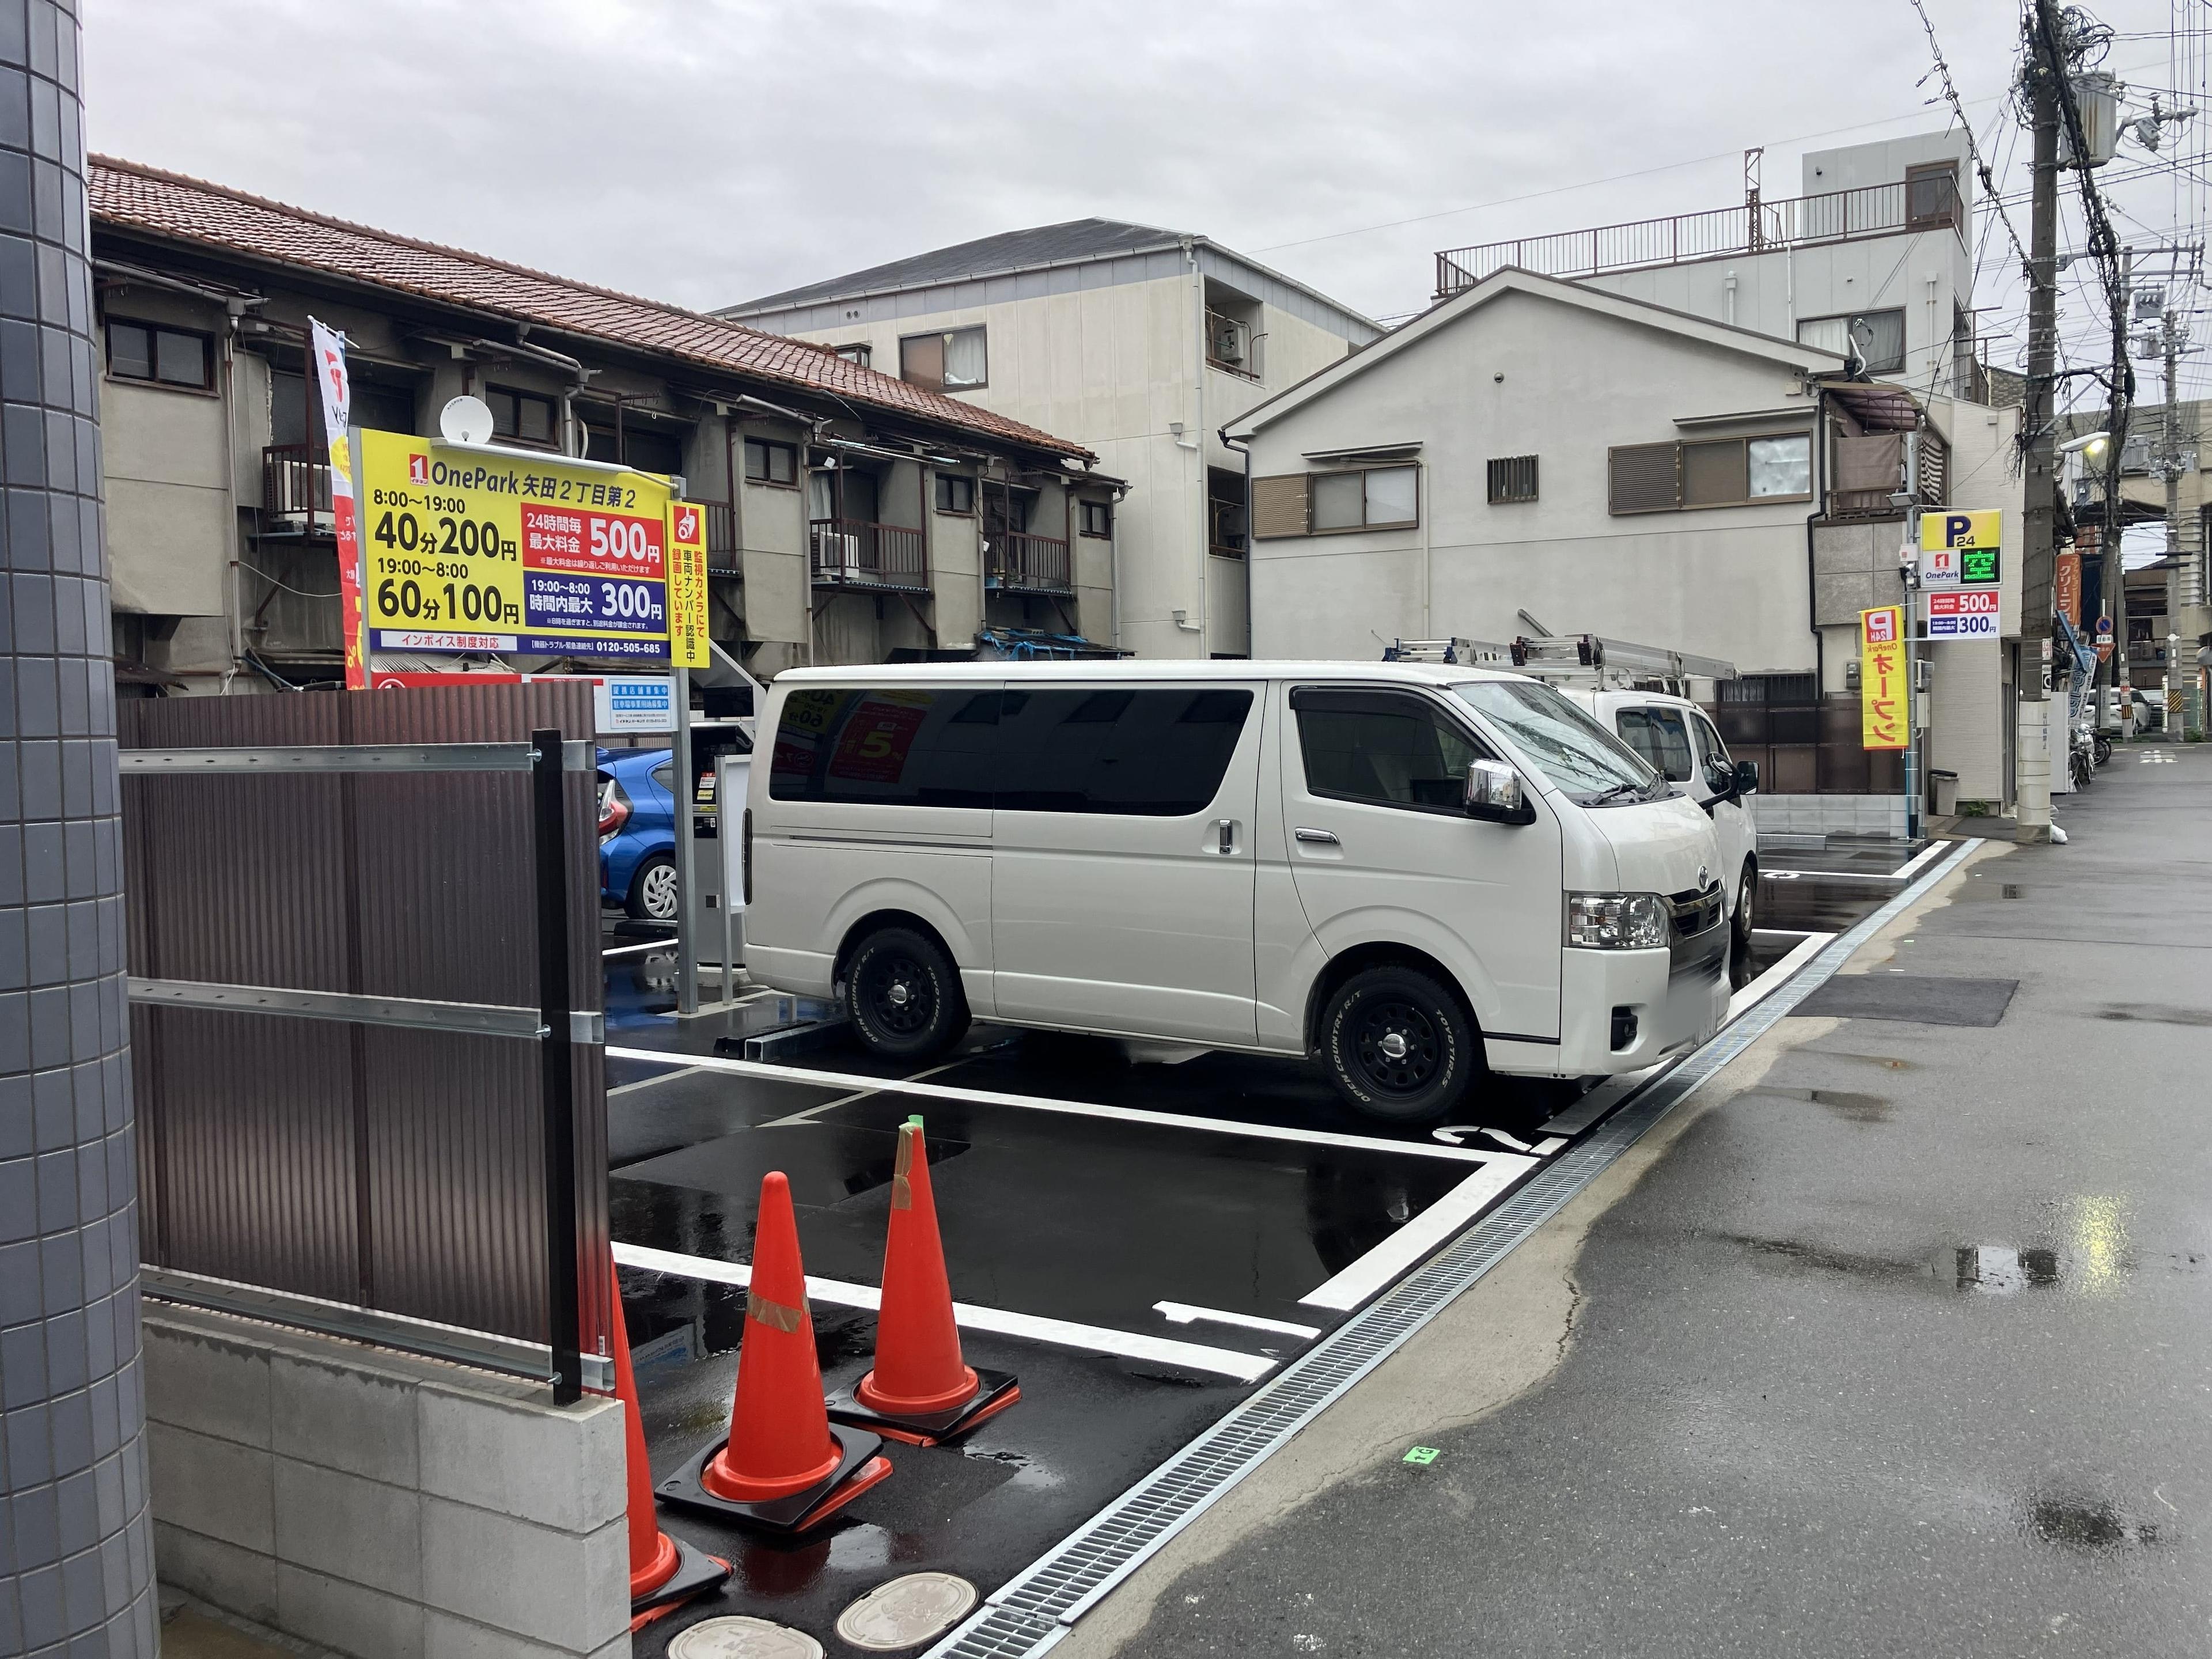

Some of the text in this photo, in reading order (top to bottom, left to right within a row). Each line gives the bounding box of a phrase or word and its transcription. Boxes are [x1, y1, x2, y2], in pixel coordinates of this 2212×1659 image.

[432, 461, 518, 495] OnePark
[527, 512, 582, 534] 24時間毎
[1946, 516, 1975, 548] P 24
[529, 532, 581, 554] 最大料金
[590, 517, 660, 563] 500円
[1926, 570, 1959, 579] OnePark
[529, 594, 593, 614] 時間内最大
[601, 582, 662, 620] 300円
[672, 548, 683, 637] 録画しています
[683, 550, 695, 663] 車両ナンバー認識中
[694, 551, 704, 638] 監視カメラにて
[1959, 593, 1997, 612] 500円
[1959, 616, 1997, 634] 300円
[402, 634, 499, 649] インボイス制度対応
[596, 641, 660, 653] 0120-505-685
[852, 963, 861, 1016] COUNTRY
[928, 964, 940, 995] TOYO
[858, 1017, 879, 1043] OPEN
[1331, 990, 1371, 1102] OPEN COUNTRY R/T
[1435, 1009, 1455, 1088] TOYO TIRES
